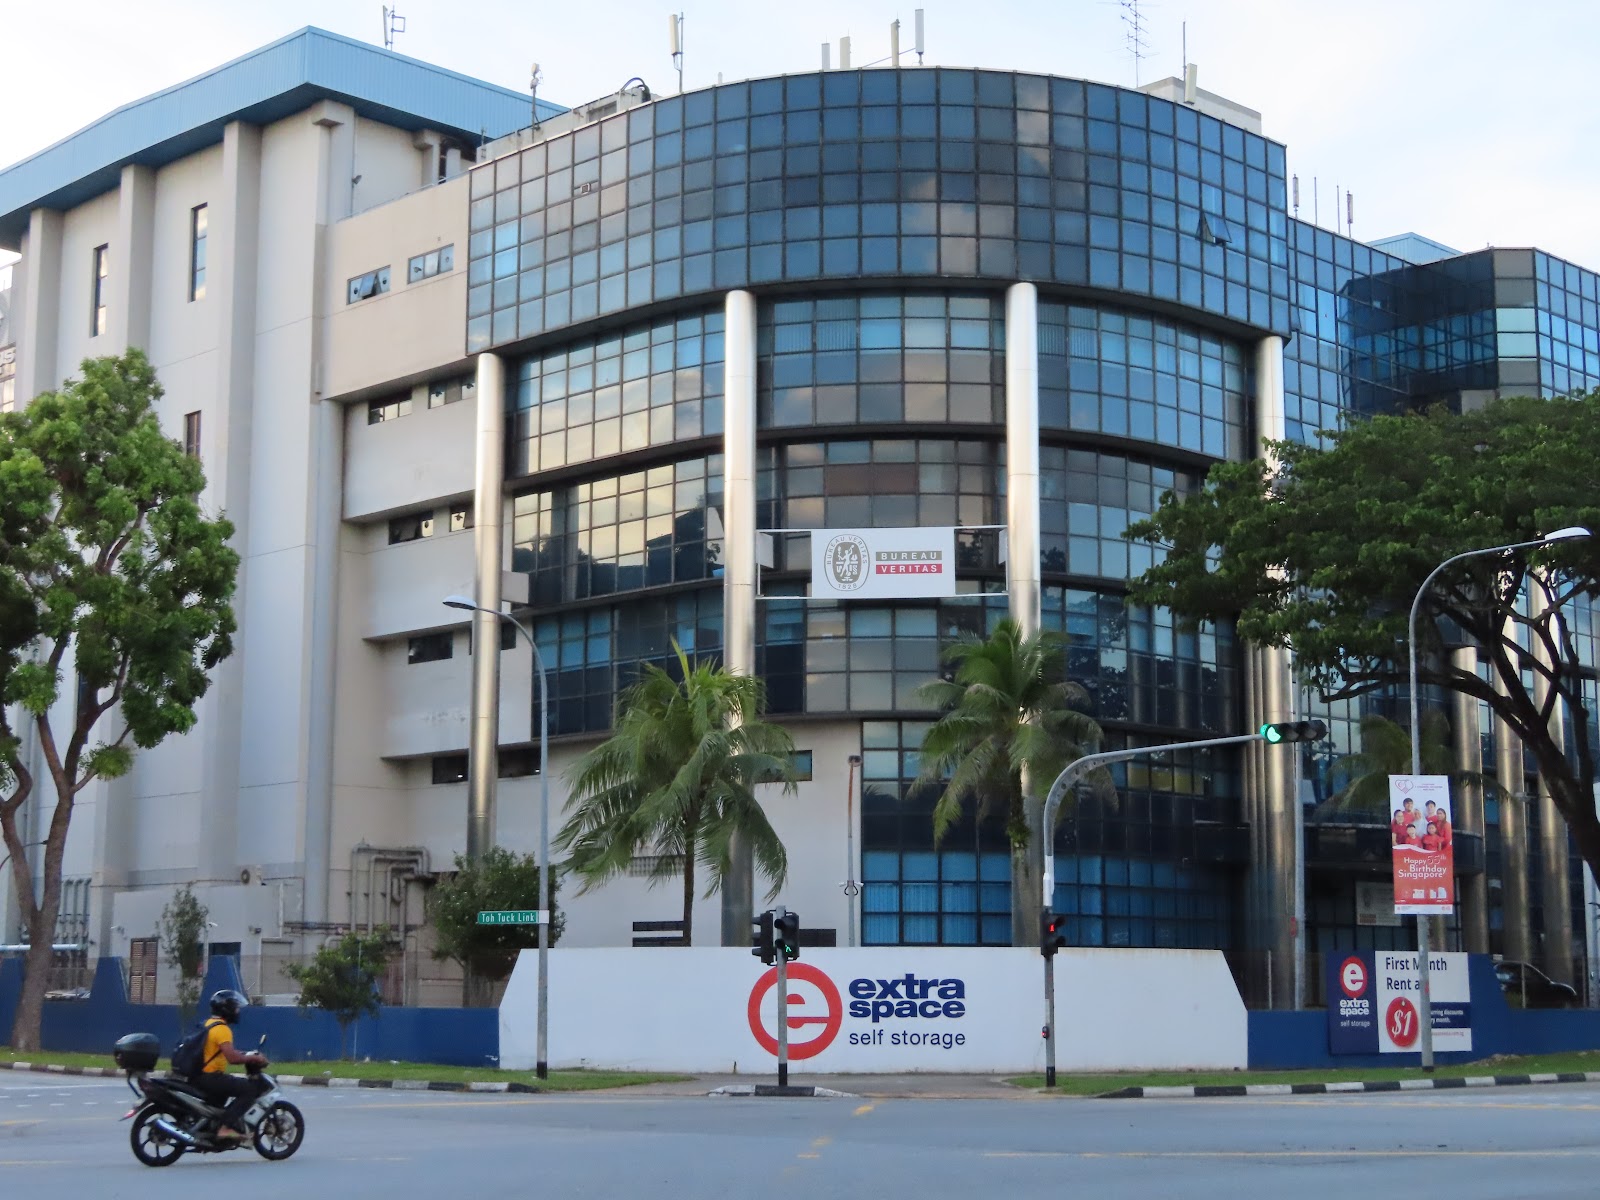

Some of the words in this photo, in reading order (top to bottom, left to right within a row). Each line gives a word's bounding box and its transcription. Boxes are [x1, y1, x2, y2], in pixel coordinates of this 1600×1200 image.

[826, 536, 845, 565] BUREAU
[848, 536, 868, 564] VERITAS
[881, 552, 937, 560] BUREAU
[881, 565, 937, 573] VERITAS
[1403, 857, 1427, 865] Happy
[1398, 869, 1443, 880] Singapore
[1409, 864, 1447, 874] Birthday
[481, 913, 495, 923] Toh
[497, 913, 515, 923] Tuck
[518, 912, 535, 922] Link
[1385, 956, 1410, 970] First
[1412, 957, 1447, 971] Mnth
[848, 973, 966, 1000] extra
[1386, 977, 1412, 990] Rent
[1339, 997, 1370, 1008] extra
[848, 1000, 966, 1023] space
[1339, 1007, 1370, 1018] space
[1340, 1019, 1350, 1027] self
[1350, 1020, 1371, 1029] storage
[1391, 1009, 1412, 1038] $1
[849, 1029, 884, 1046] self
[891, 1030, 966, 1050] storage
